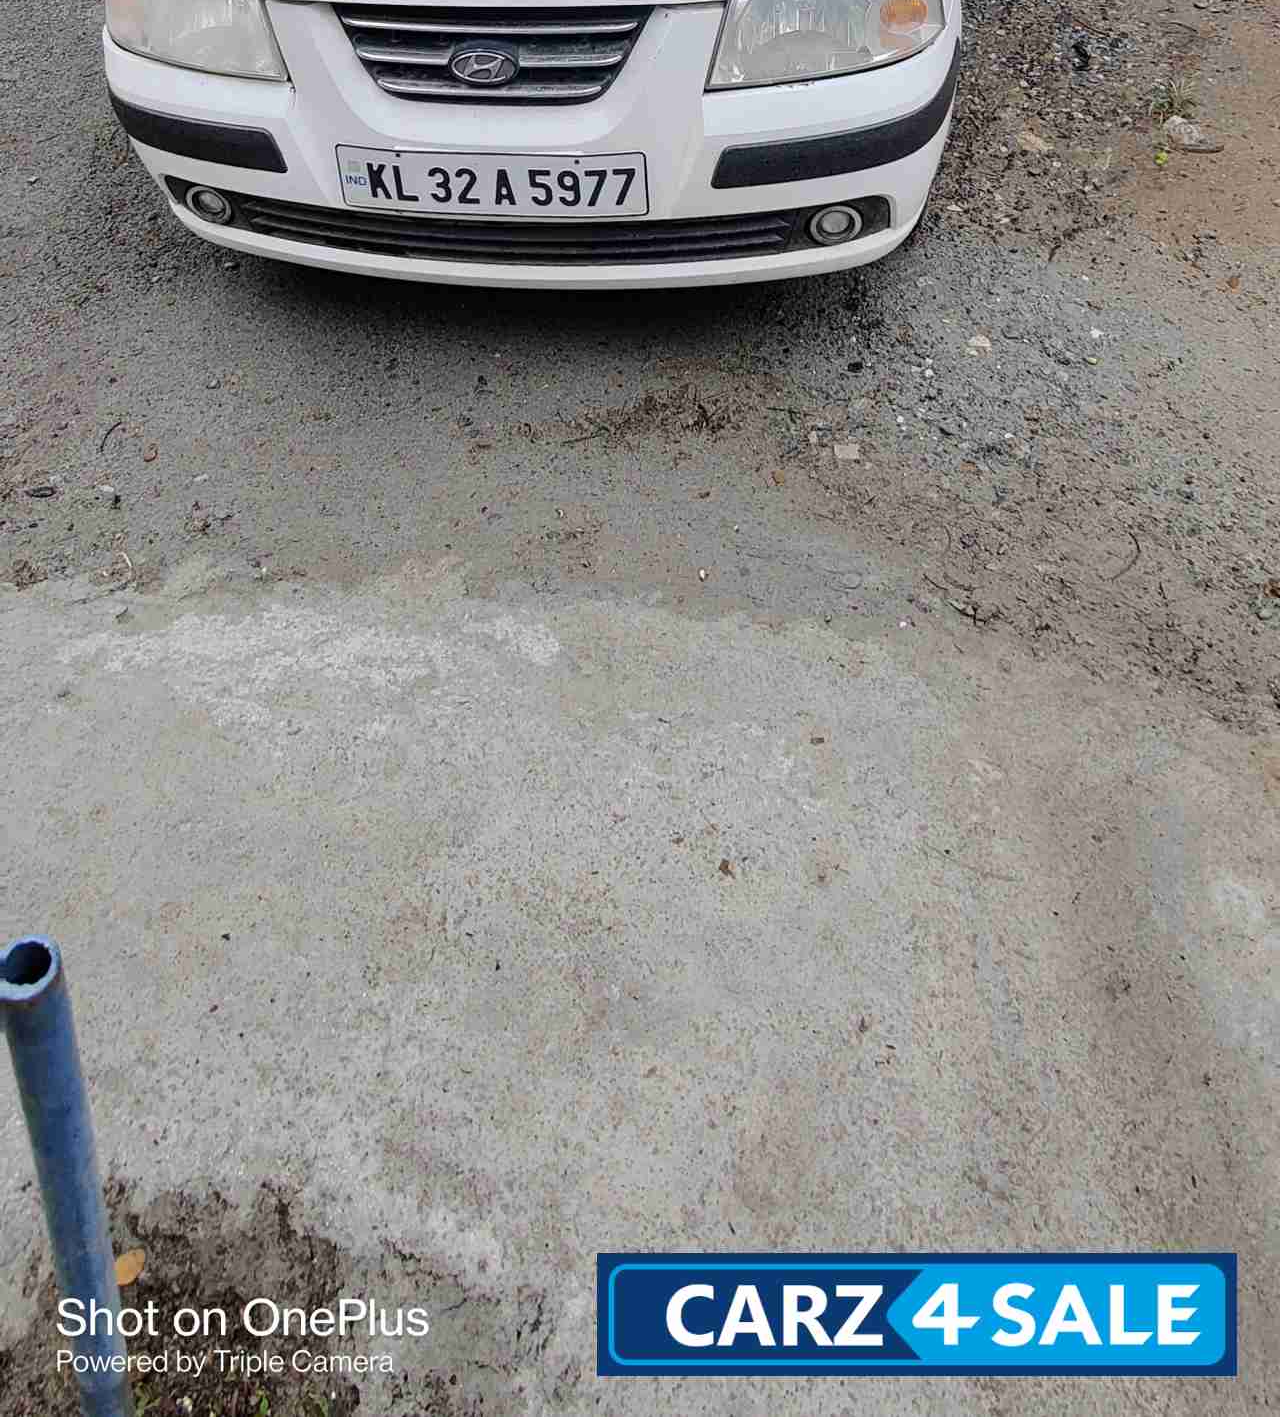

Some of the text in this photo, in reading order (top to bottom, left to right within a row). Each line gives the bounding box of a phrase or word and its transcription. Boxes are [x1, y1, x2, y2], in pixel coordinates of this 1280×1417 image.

[366, 162, 636, 207] KL 32 A 5977
